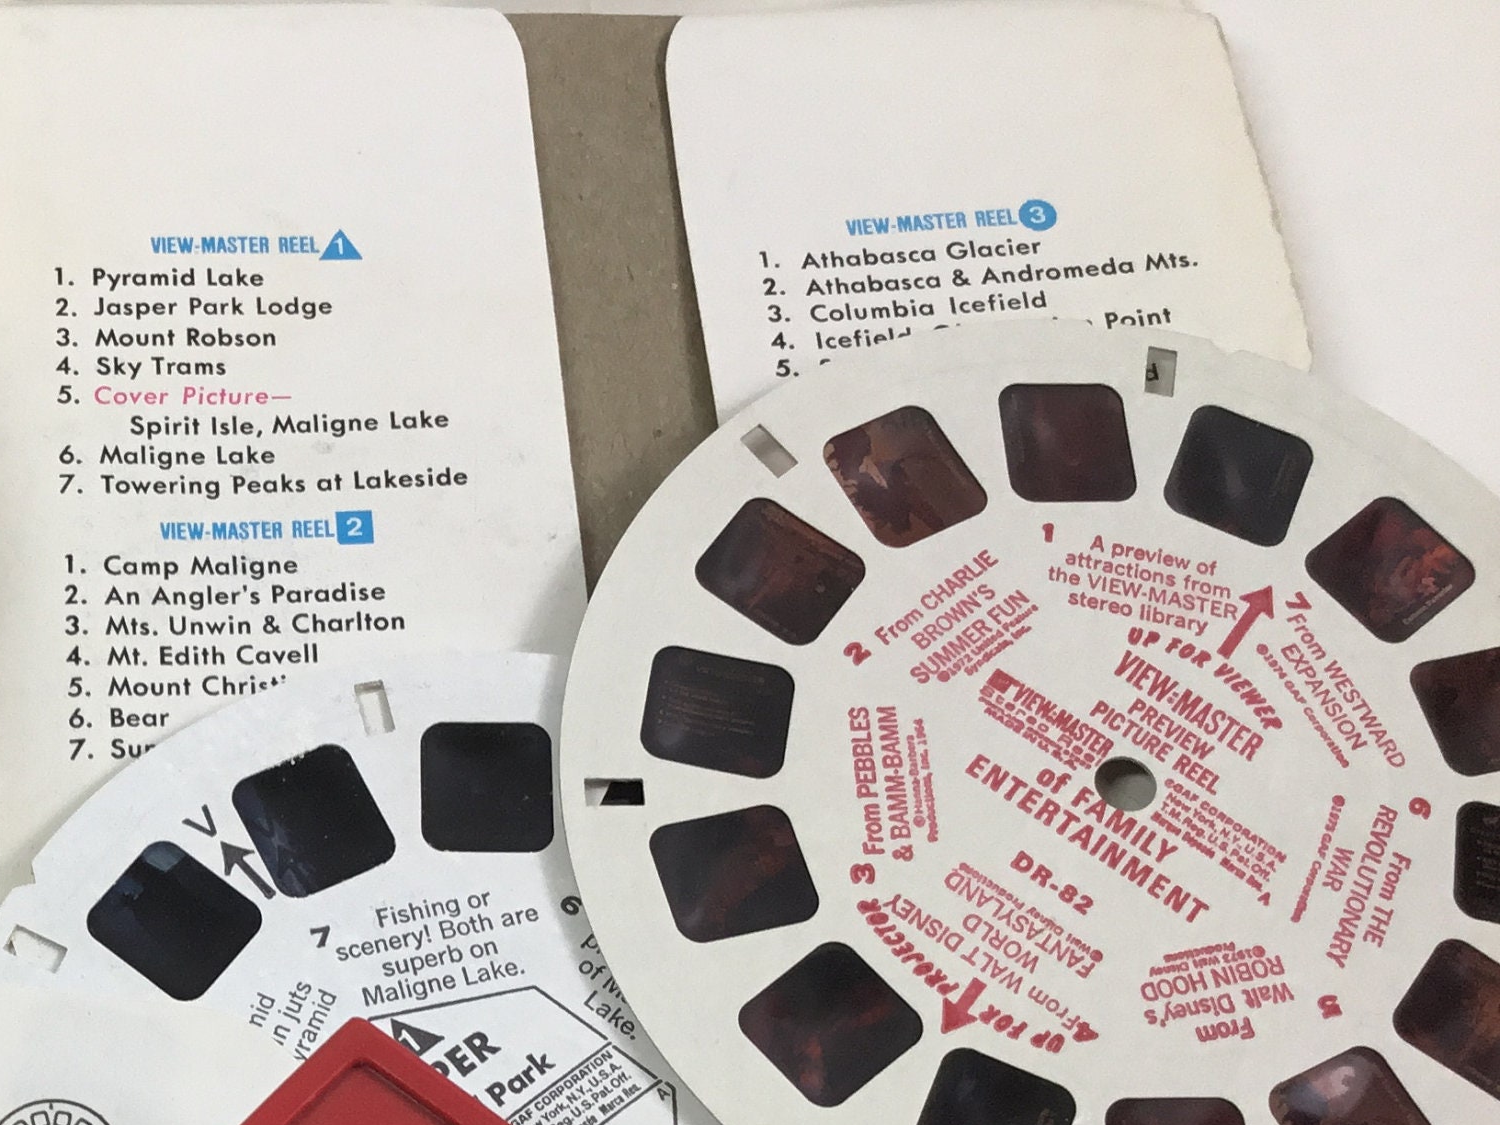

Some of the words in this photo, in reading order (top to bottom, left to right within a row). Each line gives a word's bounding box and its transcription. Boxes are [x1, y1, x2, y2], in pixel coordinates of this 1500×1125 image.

[975, 209, 1017, 227] REEL
[278, 236, 320, 253] REEL
[55, 267, 74, 286] 1.
[93, 267, 195, 292] Pyramid
[207, 268, 264, 287] Lake
[763, 277, 786, 296] 2.
[806, 274, 942, 297] Athabasca
[952, 269, 971, 287] &
[981, 257, 1134, 285] Andromeda
[1146, 253, 1198, 271] Mts.
[56, 297, 77, 317] 2.
[94, 297, 177, 320] Jasper
[189, 297, 244, 315] Park
[256, 296, 332, 320] Lodge
[768, 304, 790, 323] 3.
[810, 299, 934, 323] Columbia
[949, 290, 1047, 314] Icefield
[59, 474, 83, 494] 7.
[100, 474, 220, 500] Towering
[230, 473, 305, 494] Peaks
[317, 474, 342, 492] at
[354, 467, 468, 490] Lakeside
[292, 520, 335, 538] REEL
[1048, 565, 1084, 586] the
[1065, 550, 1177, 586] attractions
[1181, 580, 1232, 598] from
[1090, 535, 1105, 551] A
[1111, 541, 1191, 574] preview
[1195, 558, 1217, 576] of
[874, 603, 934, 646] From
[920, 548, 999, 611] CHARLIE
[910, 583, 996, 651] BROWN'S
[1068, 591, 1134, 616] stereo
[1139, 604, 1208, 636] library
[909, 622, 995, 684] SUMMER
[988, 589, 1030, 625] FUN
[68, 676, 91, 698] 5.
[108, 676, 191, 697] Mount
[848, 706, 878, 798] PEBBLES
[1089, 700, 1174, 761] PICTURE
[1173, 752, 1221, 795] REEL
[1127, 699, 1215, 761] PREVIEW
[862, 803, 885, 855] From
[1036, 767, 1072, 794] of
[1072, 785, 1179, 863] FAMILY
[893, 842, 914, 861] &
[965, 754, 1209, 922] ENTERTAINMENT
[1010, 850, 1094, 916] DR-82
[375, 895, 462, 929] Fishing
[466, 889, 492, 908] or
[310, 926, 331, 948] 7
[335, 926, 433, 963] scenery!
[439, 915, 493, 941] Both
[501, 904, 539, 927] are
[382, 945, 463, 979] superb
[469, 938, 499, 959] on
[362, 972, 457, 1008] Maligne
[462, 961, 526, 988] Lake.
[485, 1052, 556, 1109] Park
